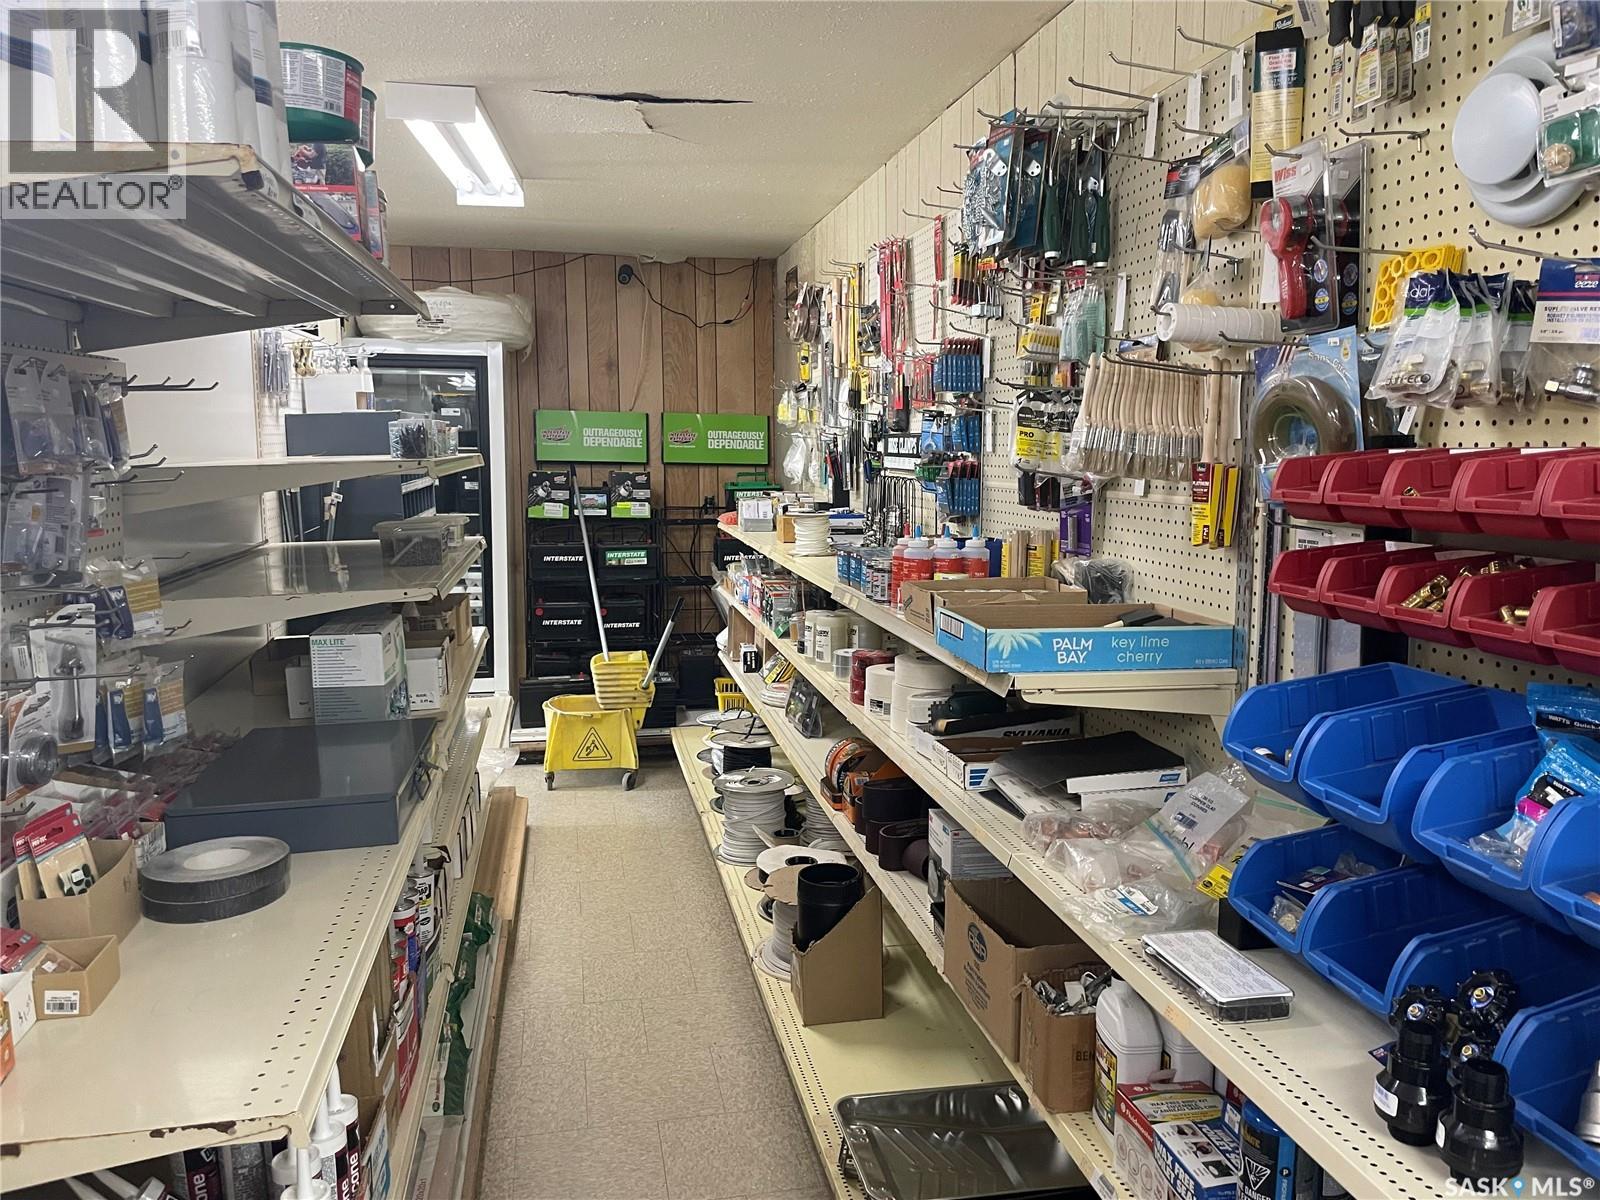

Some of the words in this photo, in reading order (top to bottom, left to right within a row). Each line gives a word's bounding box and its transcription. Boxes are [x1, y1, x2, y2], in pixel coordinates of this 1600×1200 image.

[583, 428, 643, 438] OUTRAGEOUSLY
[707, 430, 765, 440] OUTRAGEOUSLY
[1019, 430, 1034, 438] PRO
[583, 437, 643, 448] DEPENDABLE
[708, 439, 765, 449] DEPENDABLE
[330, 638, 345, 646] LITE
[1053, 638, 1093, 652] PALM
[1112, 637, 1134, 649] key
[1141, 636, 1170, 648] lime
[1117, 650, 1163, 665] cherry
[1548, 714, 1570, 725] WATTS
[1552, 780, 1576, 795] WATTS
[1175, 1162, 1195, 1193] FREE
